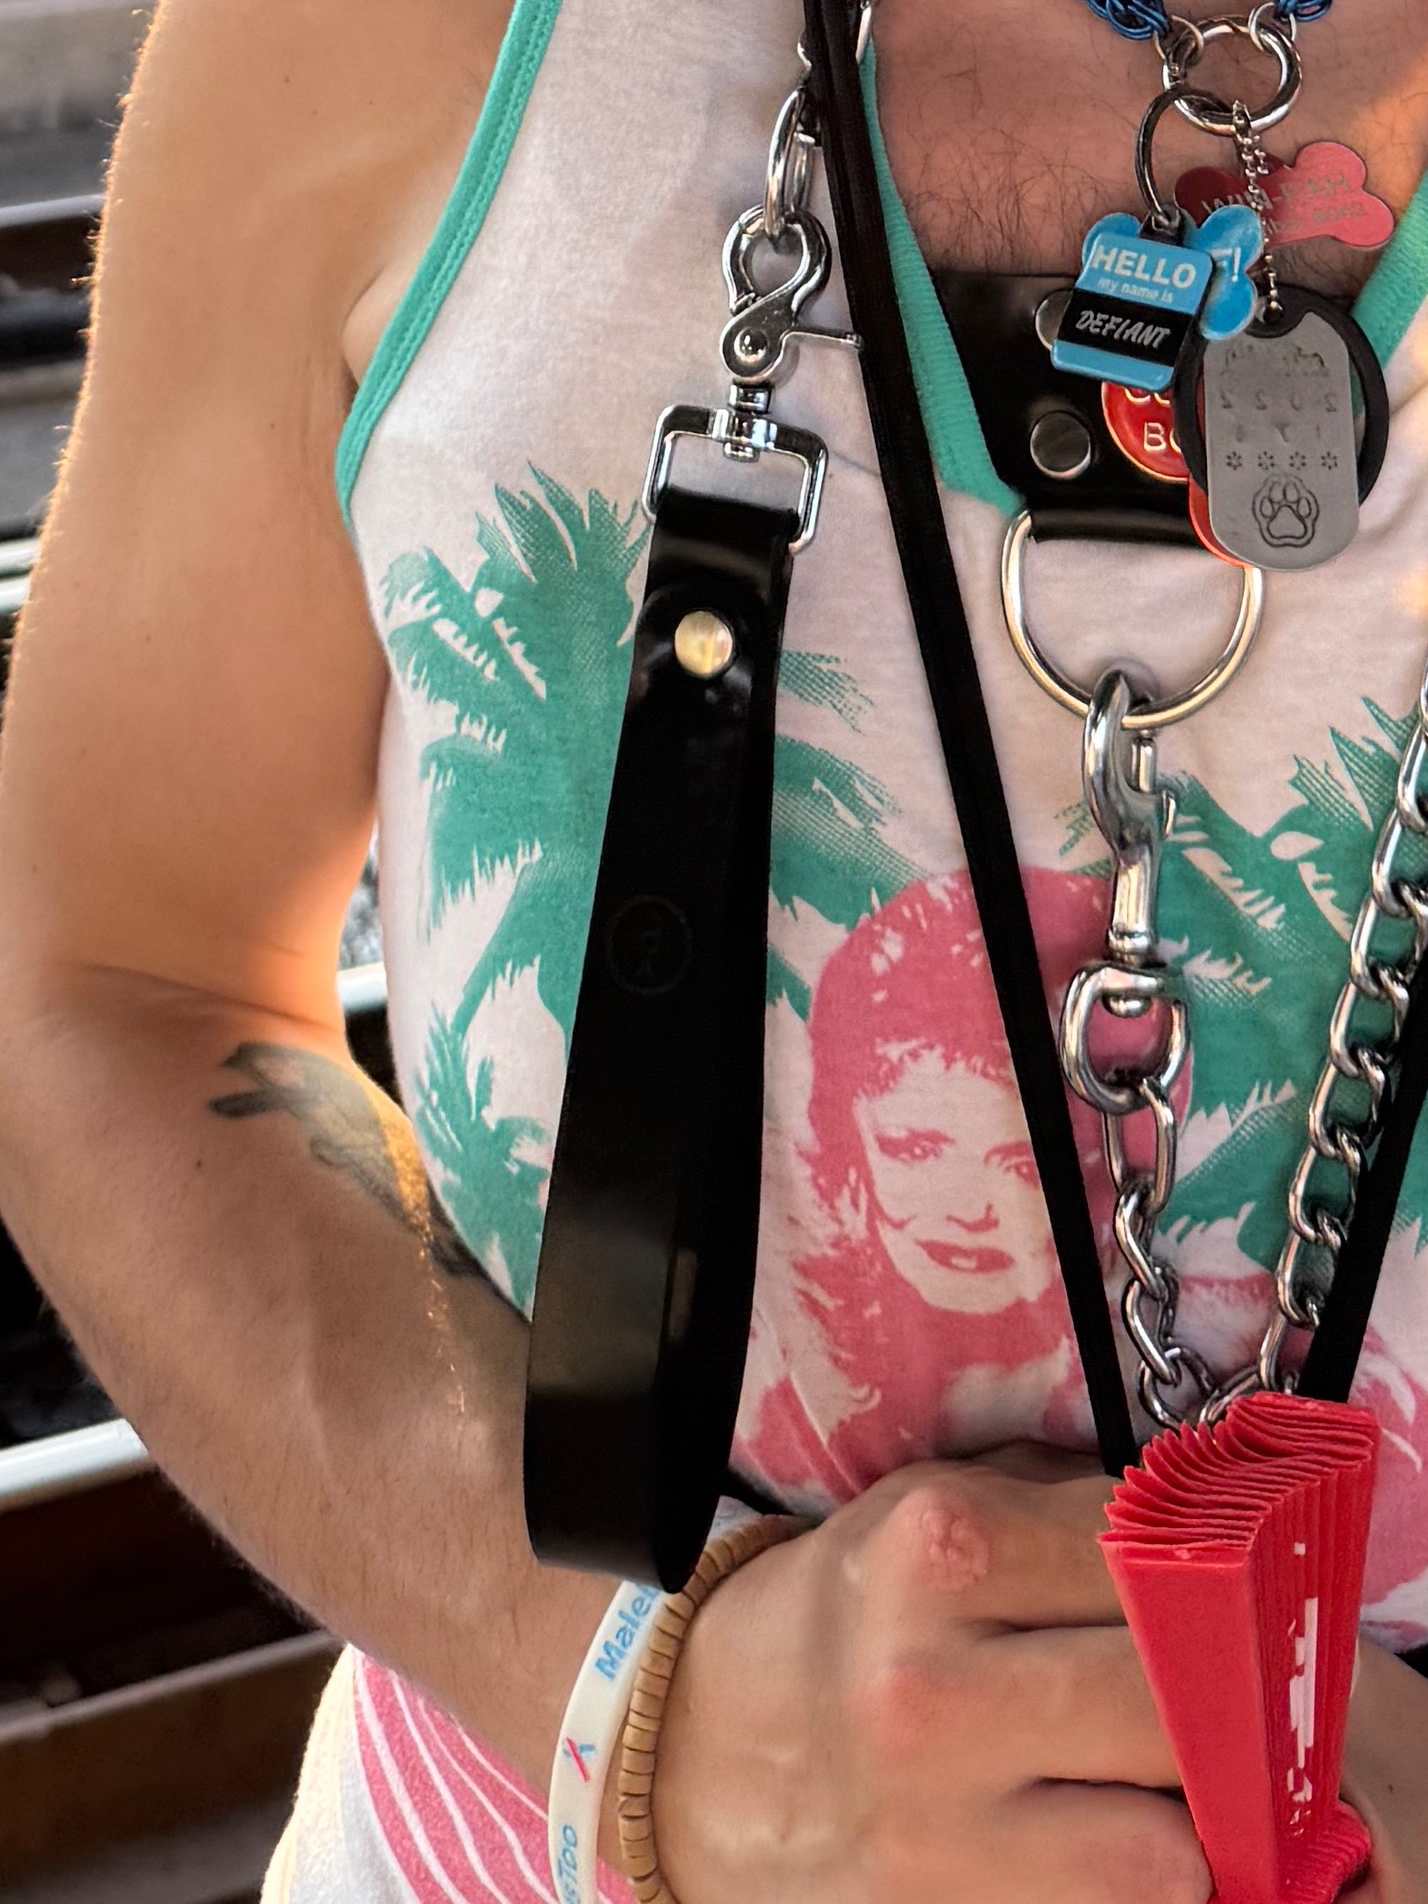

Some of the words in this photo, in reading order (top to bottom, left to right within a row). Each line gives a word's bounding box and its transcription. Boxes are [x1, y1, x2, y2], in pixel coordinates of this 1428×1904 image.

[1091, 244, 1197, 289] HELLO
[1098, 277, 1118, 291] my
[1121, 281, 1161, 300] name
[1075, 309, 1172, 349] DEFIANT
